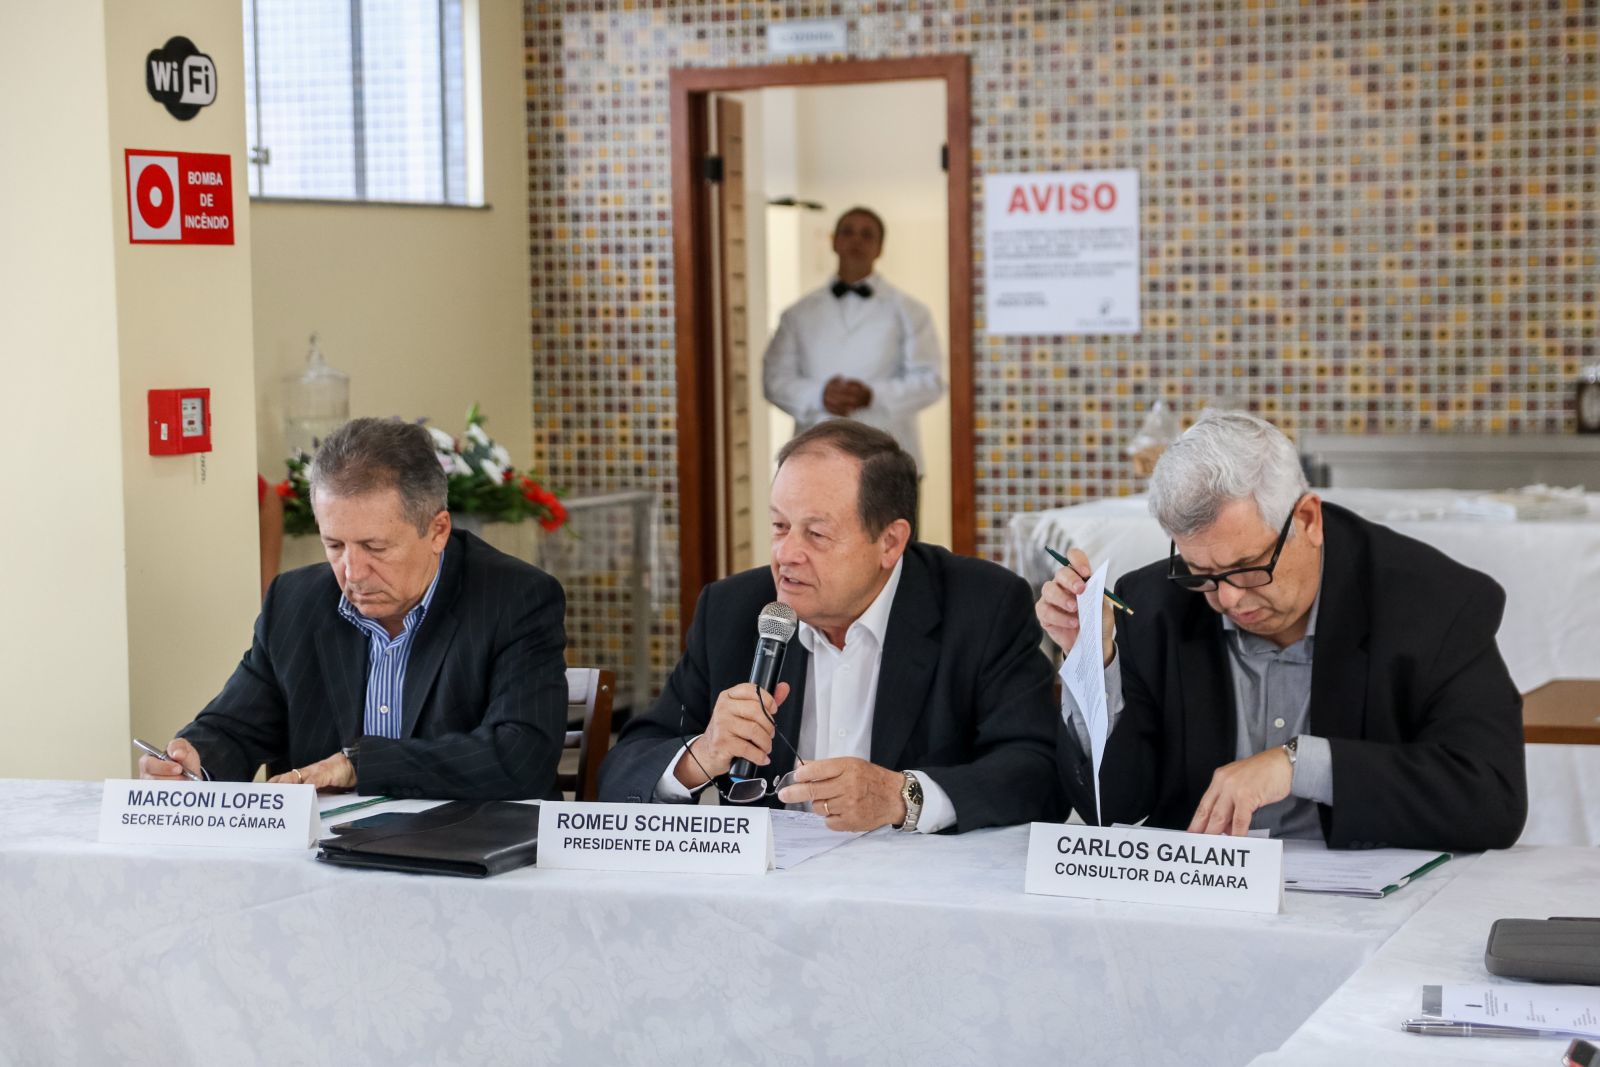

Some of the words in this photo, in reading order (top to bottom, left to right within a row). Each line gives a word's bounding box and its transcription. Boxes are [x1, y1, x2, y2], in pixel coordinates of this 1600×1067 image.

[187, 171, 223, 185] BOMBA
[199, 194, 214, 207] DE
[1007, 182, 1118, 214] AVISO
[185, 212, 229, 229] INCÊNDIO
[127, 789, 216, 808] MARCONI
[221, 792, 284, 810] LOPES
[121, 811, 204, 827] SECRETÁRIO
[207, 816, 226, 828] DA
[229, 813, 286, 829] CÂMARA
[557, 813, 628, 831] ROMEU
[634, 814, 750, 834] SCHNEIDER
[563, 836, 651, 851] PRESIDENTE
[655, 840, 675, 853] DA
[678, 837, 741, 854] CÂMARA
[1056, 836, 1150, 860] CARLOS
[1157, 843, 1251, 868] GALANT
[1055, 862, 1149, 882] CONSULTOR
[1153, 870, 1176, 884] DA
[1180, 869, 1249, 890] CÂMARA
